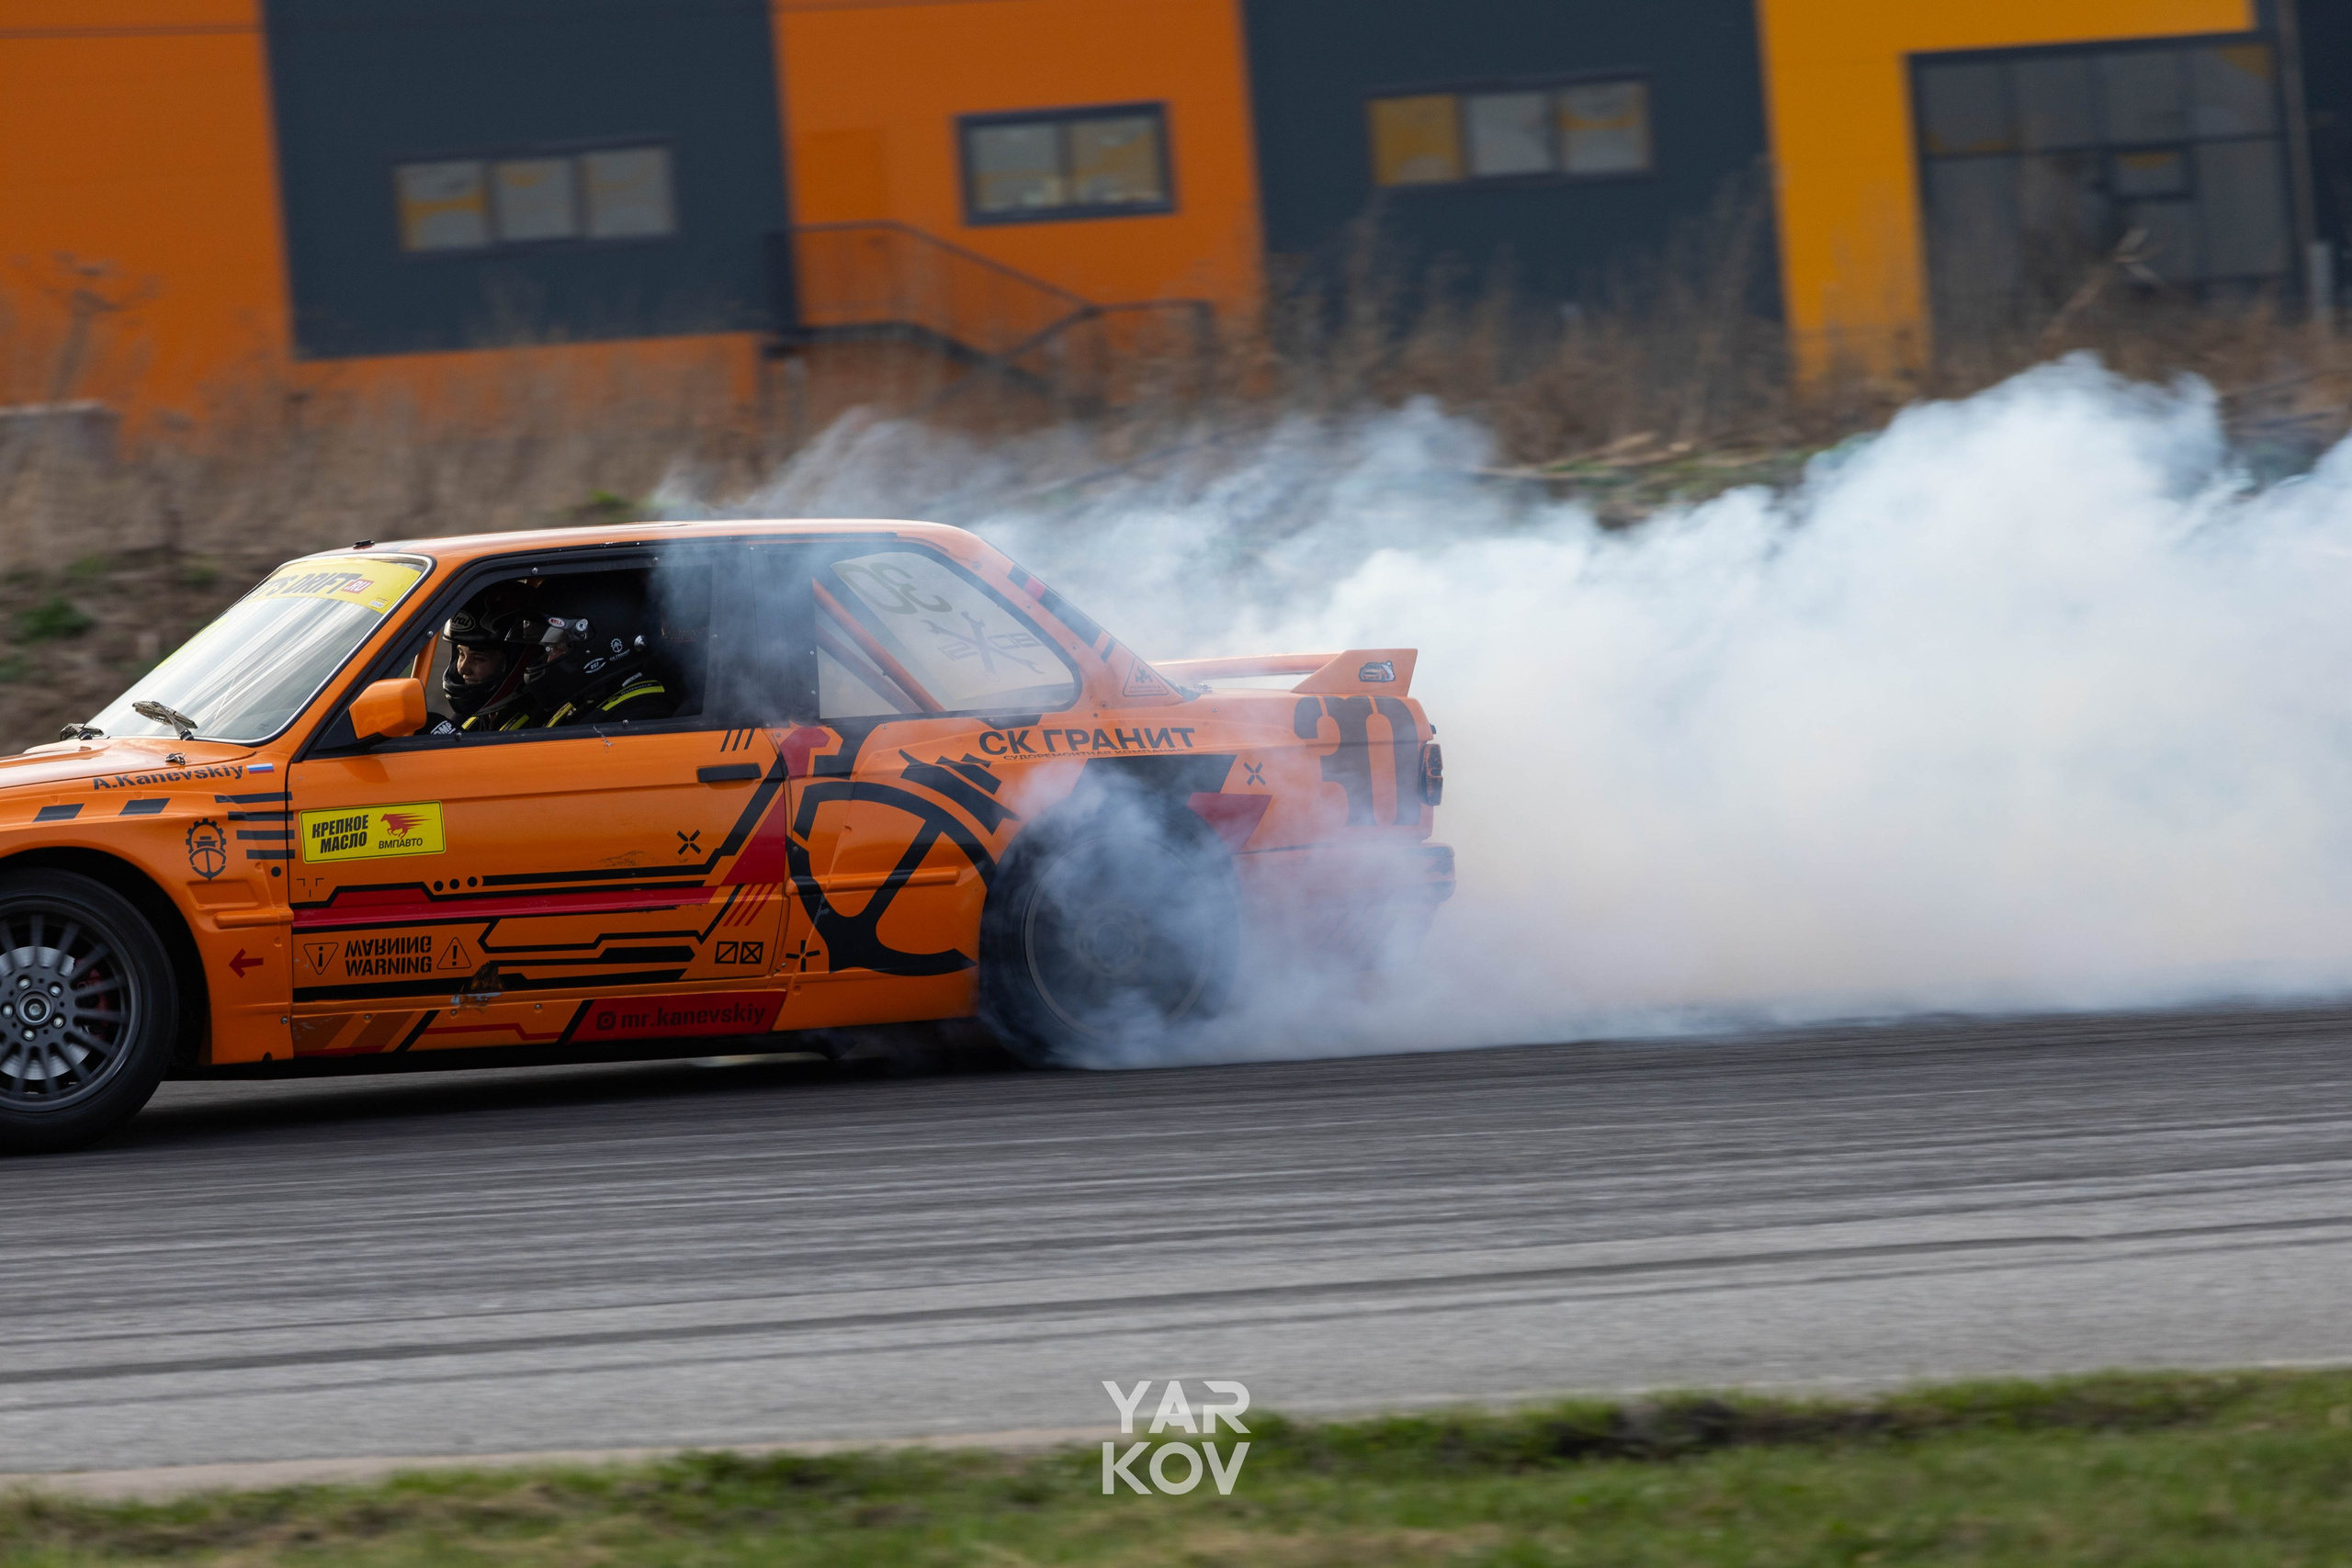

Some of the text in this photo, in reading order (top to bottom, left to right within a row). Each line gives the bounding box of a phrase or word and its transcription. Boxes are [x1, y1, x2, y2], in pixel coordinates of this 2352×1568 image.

[280, 572, 363, 595] DRIFT
[978, 728, 1195, 756] СК ГРАНИТ
[1003, 748, 1185, 761] СУДОРЕМОНТНАЯ КОМПАНИЯ
[1294, 694, 1421, 826] 30
[93, 764, 243, 790] A.Kanevskiy
[311, 814, 369, 839] КРЕПКОЕ
[320, 831, 368, 853] МАСЛО
[379, 837, 424, 850] ВМПАВТО
[345, 955, 432, 976] WARNING
[621, 1002, 766, 1029] mr.kanevskiy
